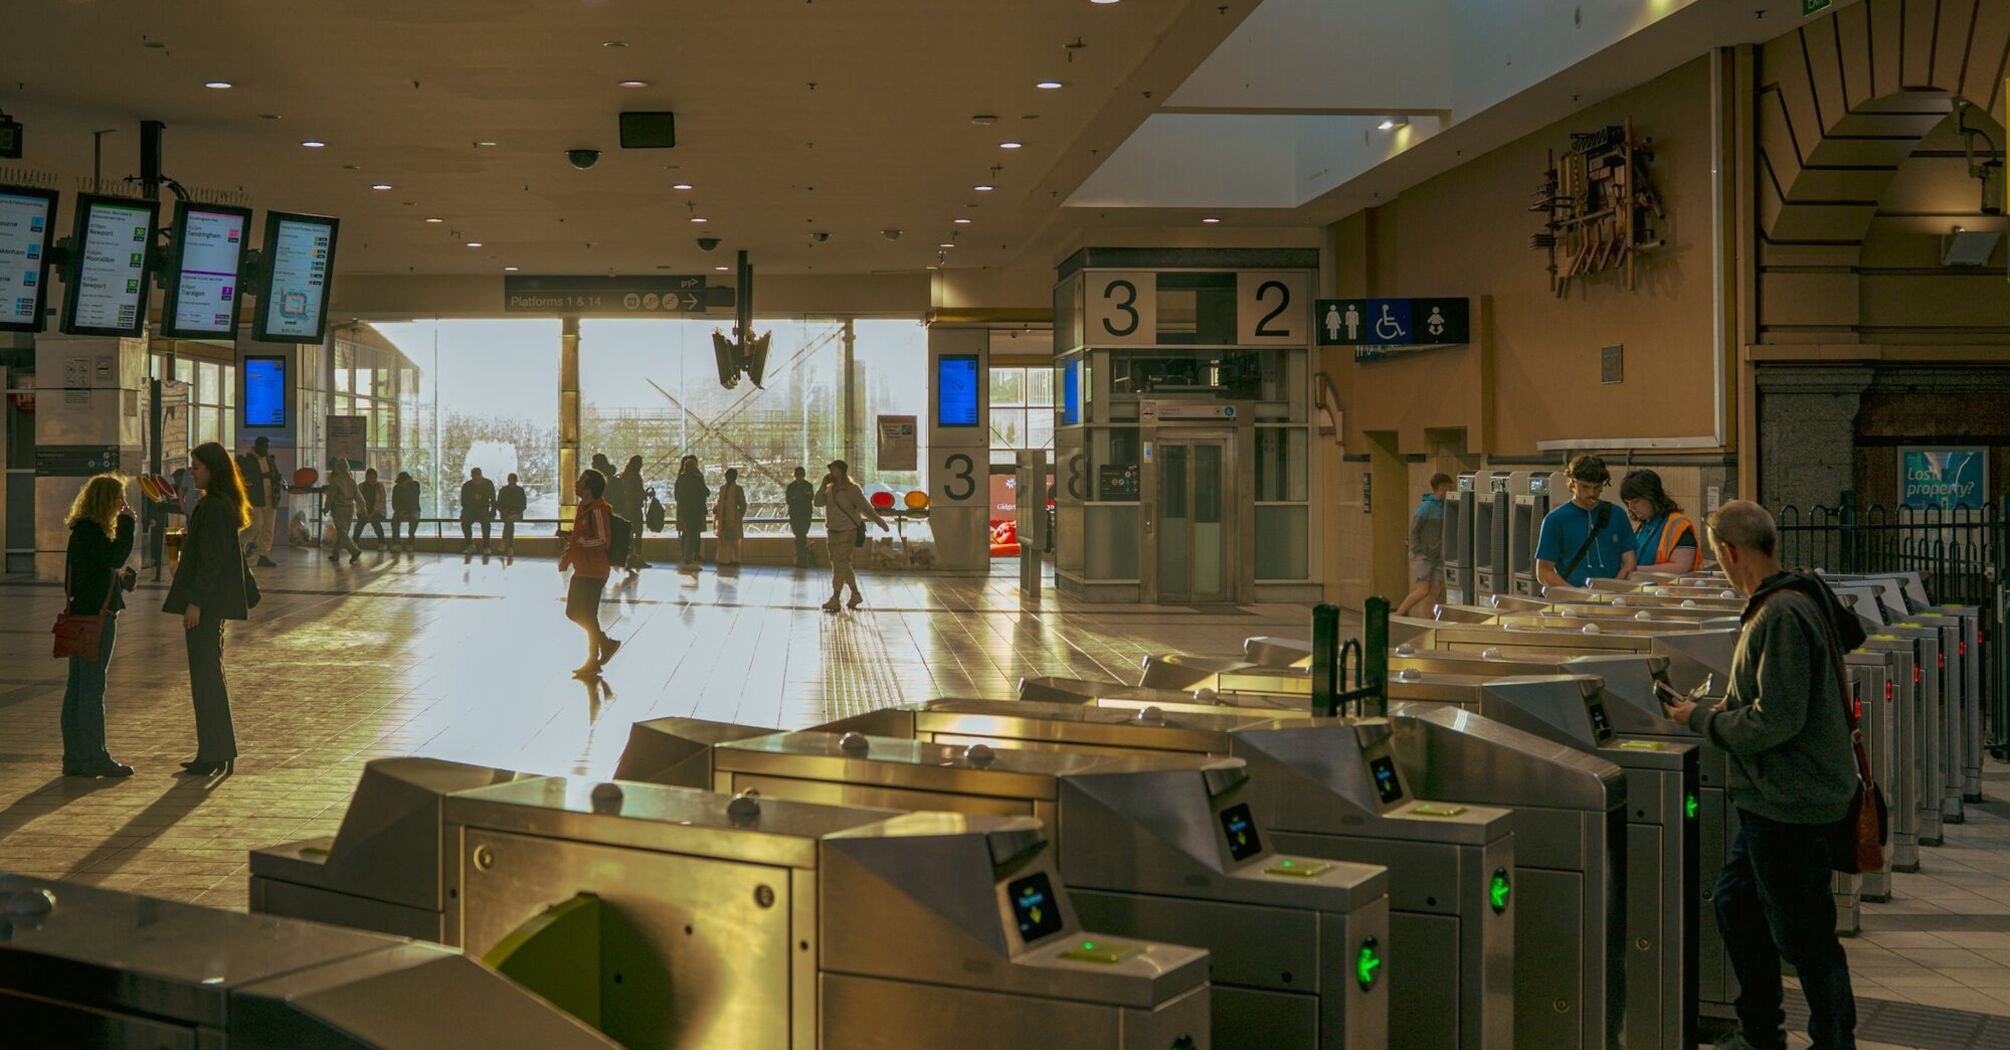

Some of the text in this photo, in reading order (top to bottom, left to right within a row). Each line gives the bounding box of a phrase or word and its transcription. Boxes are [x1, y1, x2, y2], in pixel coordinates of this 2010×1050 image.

[511, 295, 601, 308] Platforms 1 & 14
[1102, 280, 1139, 337] 3
[1254, 280, 1291, 337] 2
[943, 453, 976, 501] 3
[1907, 466, 1937, 481] Lost
[1907, 481, 1976, 498] property?
